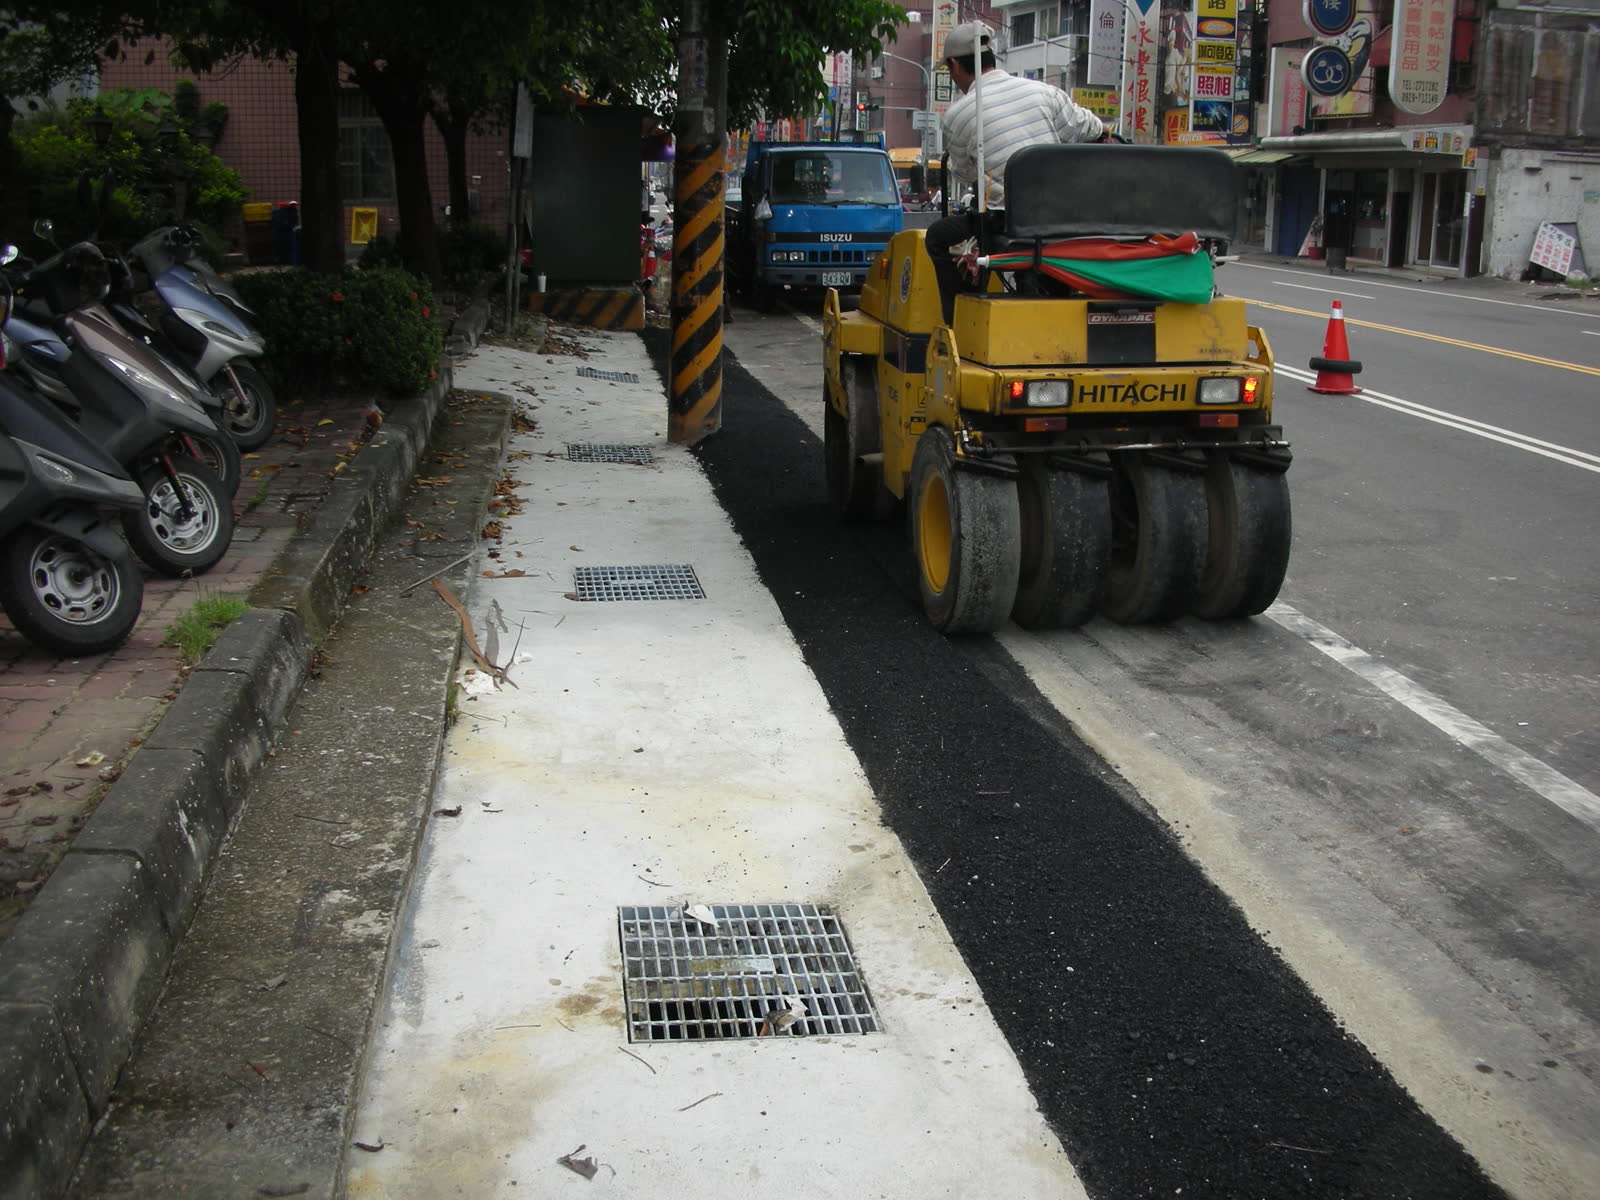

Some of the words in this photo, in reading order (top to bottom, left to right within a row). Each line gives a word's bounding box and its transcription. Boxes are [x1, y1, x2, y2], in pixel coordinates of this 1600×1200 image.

[1099, 12, 1115, 29] 倫
[1197, 76, 1231, 96] 照相
[820, 234, 852, 242] ISUZU
[1090, 313, 1153, 323] DYNAPAC
[1078, 383, 1186, 403] HITACHI
